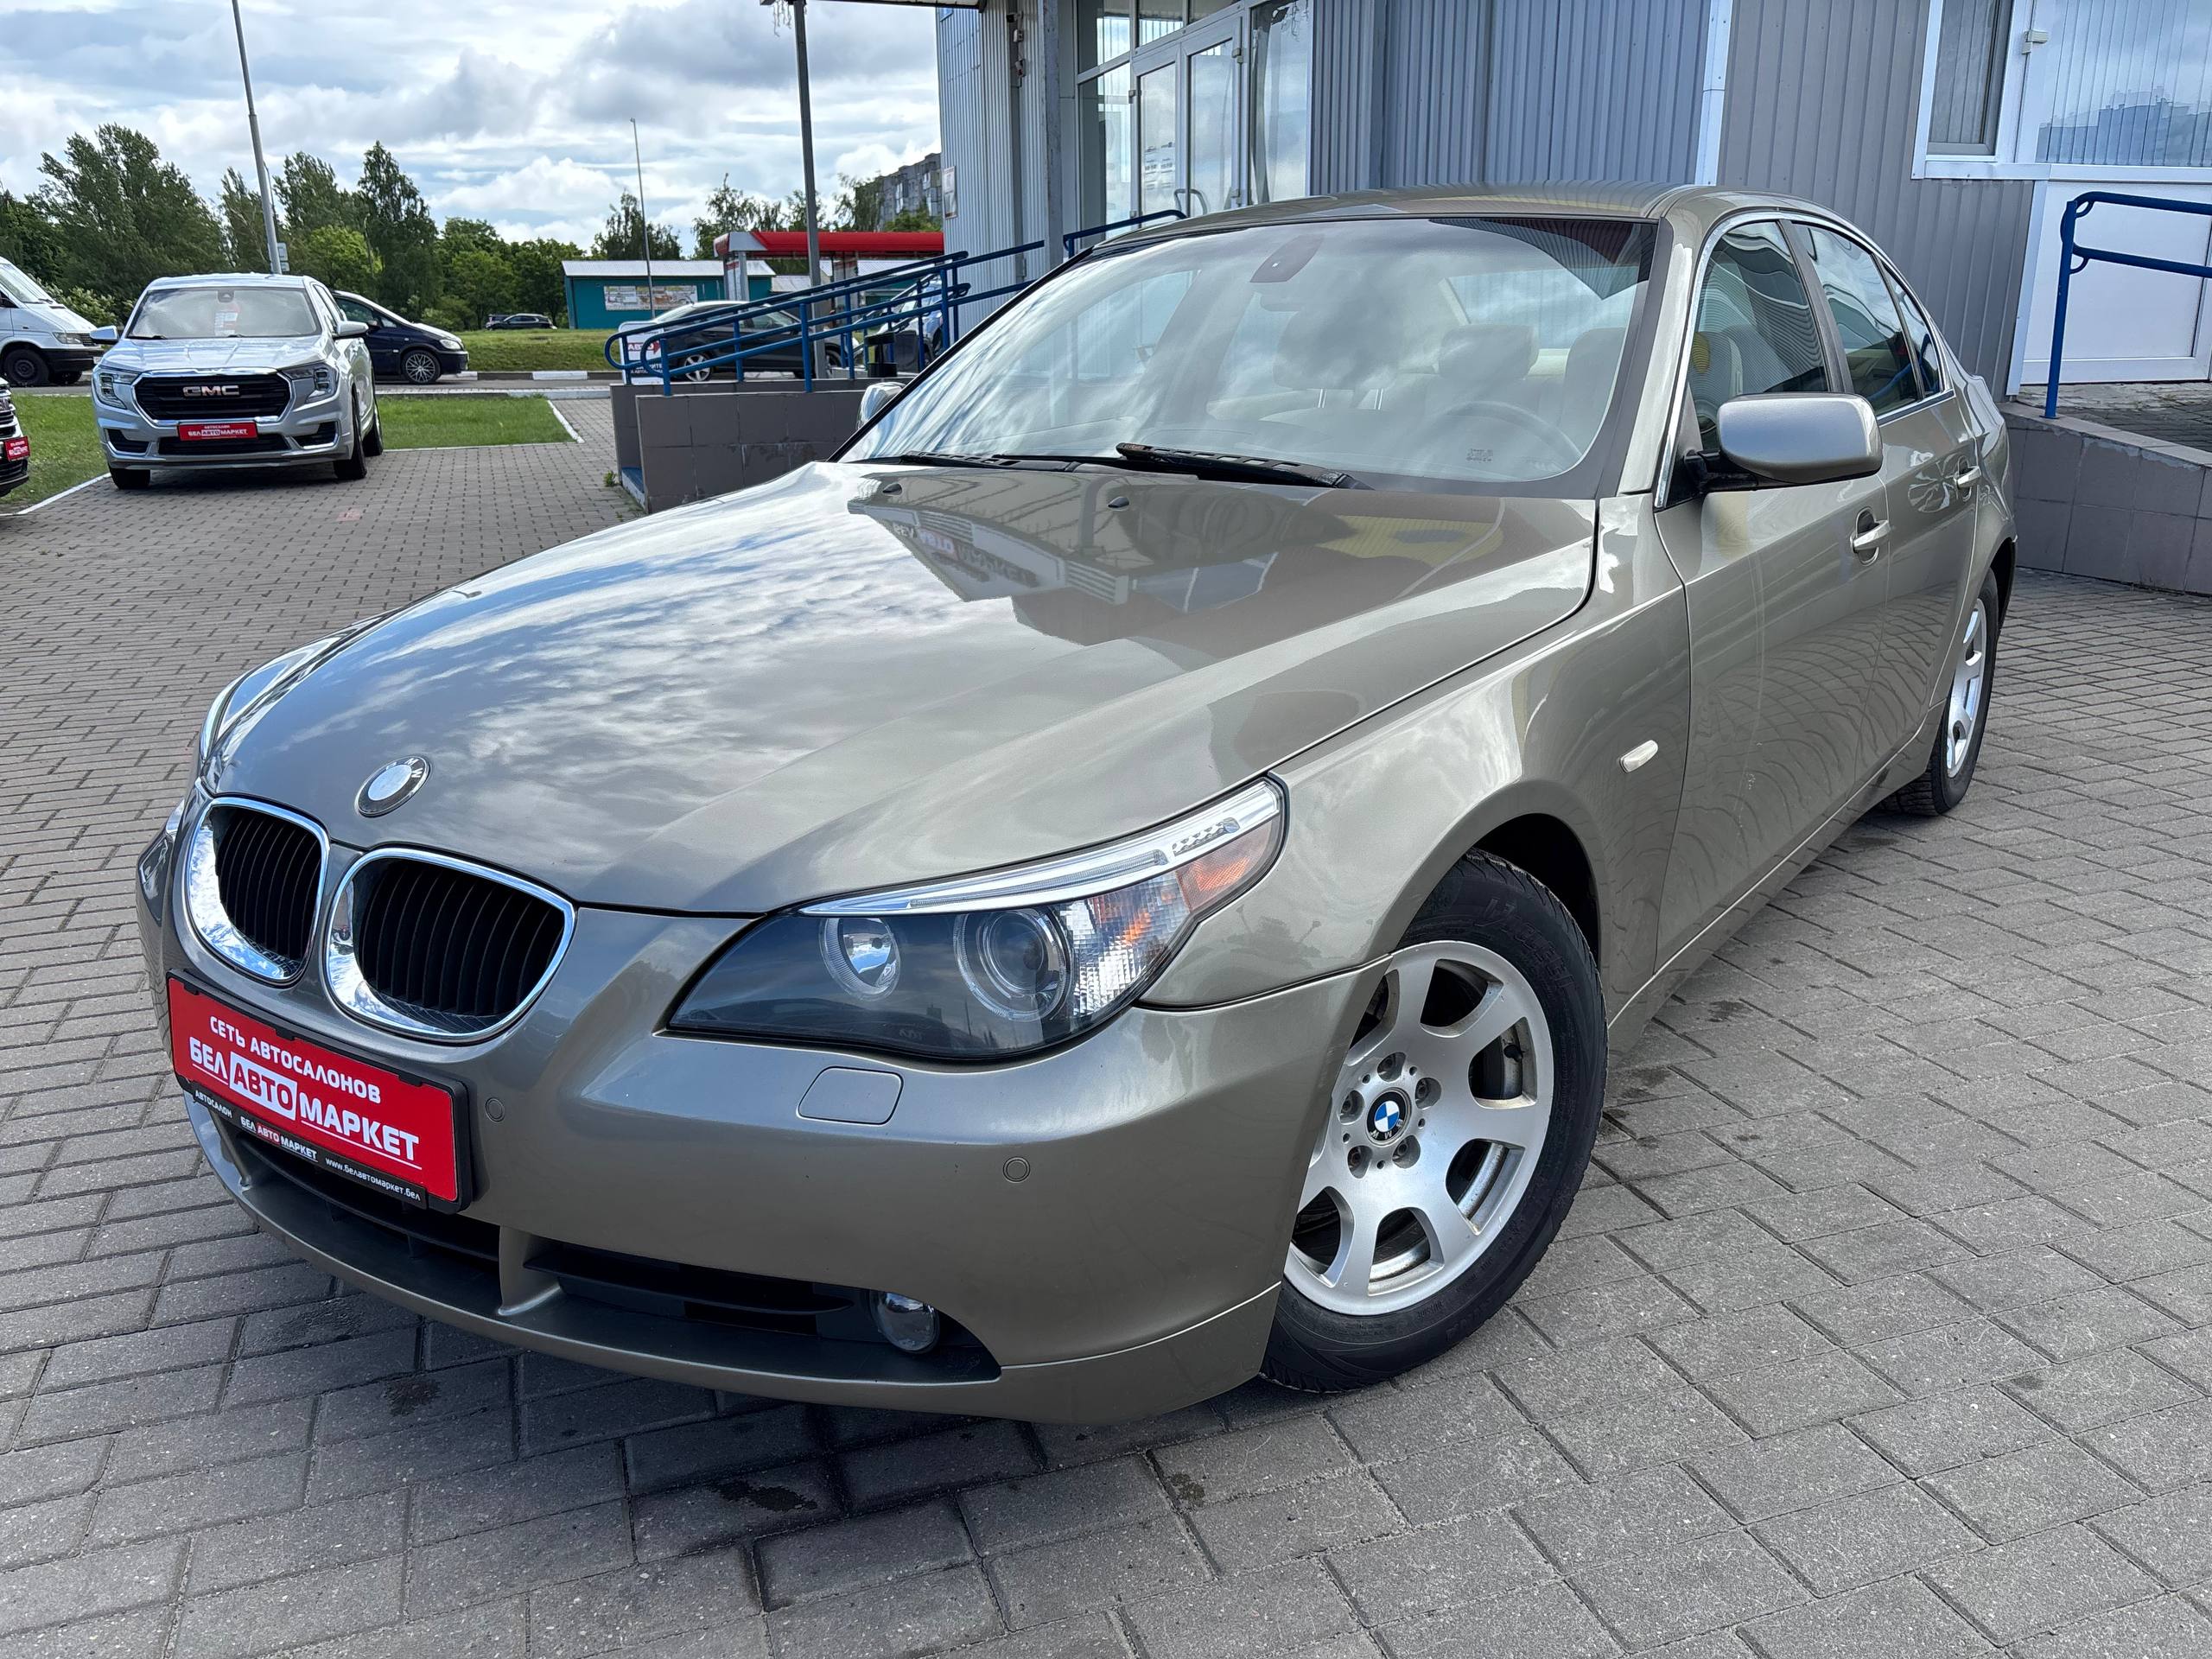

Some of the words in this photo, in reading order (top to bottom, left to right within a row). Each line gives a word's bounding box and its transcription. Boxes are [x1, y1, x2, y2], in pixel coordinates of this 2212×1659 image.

[182, 385, 239, 396] GMC
[189, 1036, 227, 1079] БЕЛ
[233, 1057, 294, 1112] АВТО
[299, 1091, 419, 1161] МАРКЕТ
[209, 1015, 245, 1048] СЕТЬ
[250, 1037, 381, 1104] АВТОСАЛОНОВ
[194, 1090, 232, 1119] АВТОСАЛОН
[240, 1116, 257, 1132] БЕЛ
[257, 1125, 279, 1142] АВТО
[281, 1135, 317, 1160] МАРКЕТ
[325, 1158, 421, 1201] www.белавтомаркет.бел
[1370, 1117, 1404, 1140] BMW
